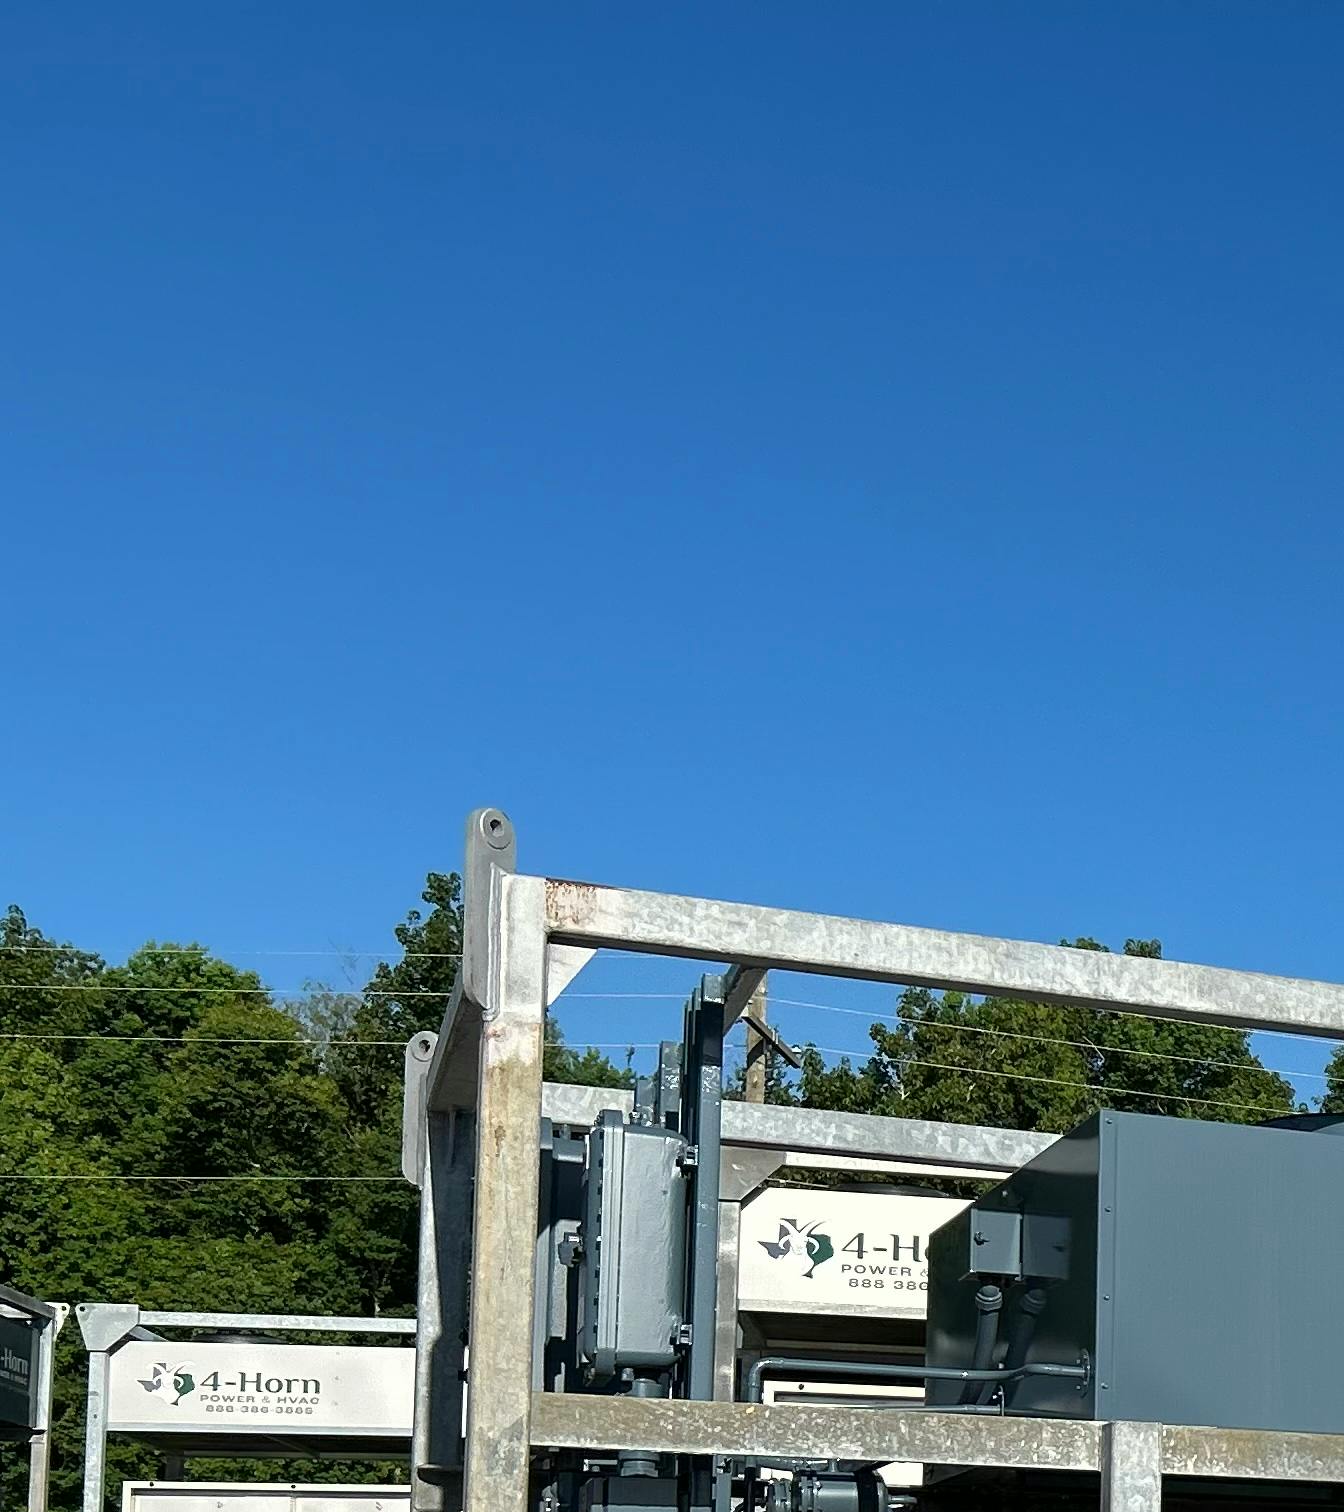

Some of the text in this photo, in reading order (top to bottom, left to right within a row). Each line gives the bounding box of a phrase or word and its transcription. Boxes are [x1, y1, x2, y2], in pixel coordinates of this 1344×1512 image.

[841, 1233, 928, 1262] 4-H
[841, 1264, 912, 1277] POWER
[200, 1371, 320, 1394] 4-Horn
[200, 1394, 255, 1403] POWER
[277, 1396, 319, 1405] HVAC
